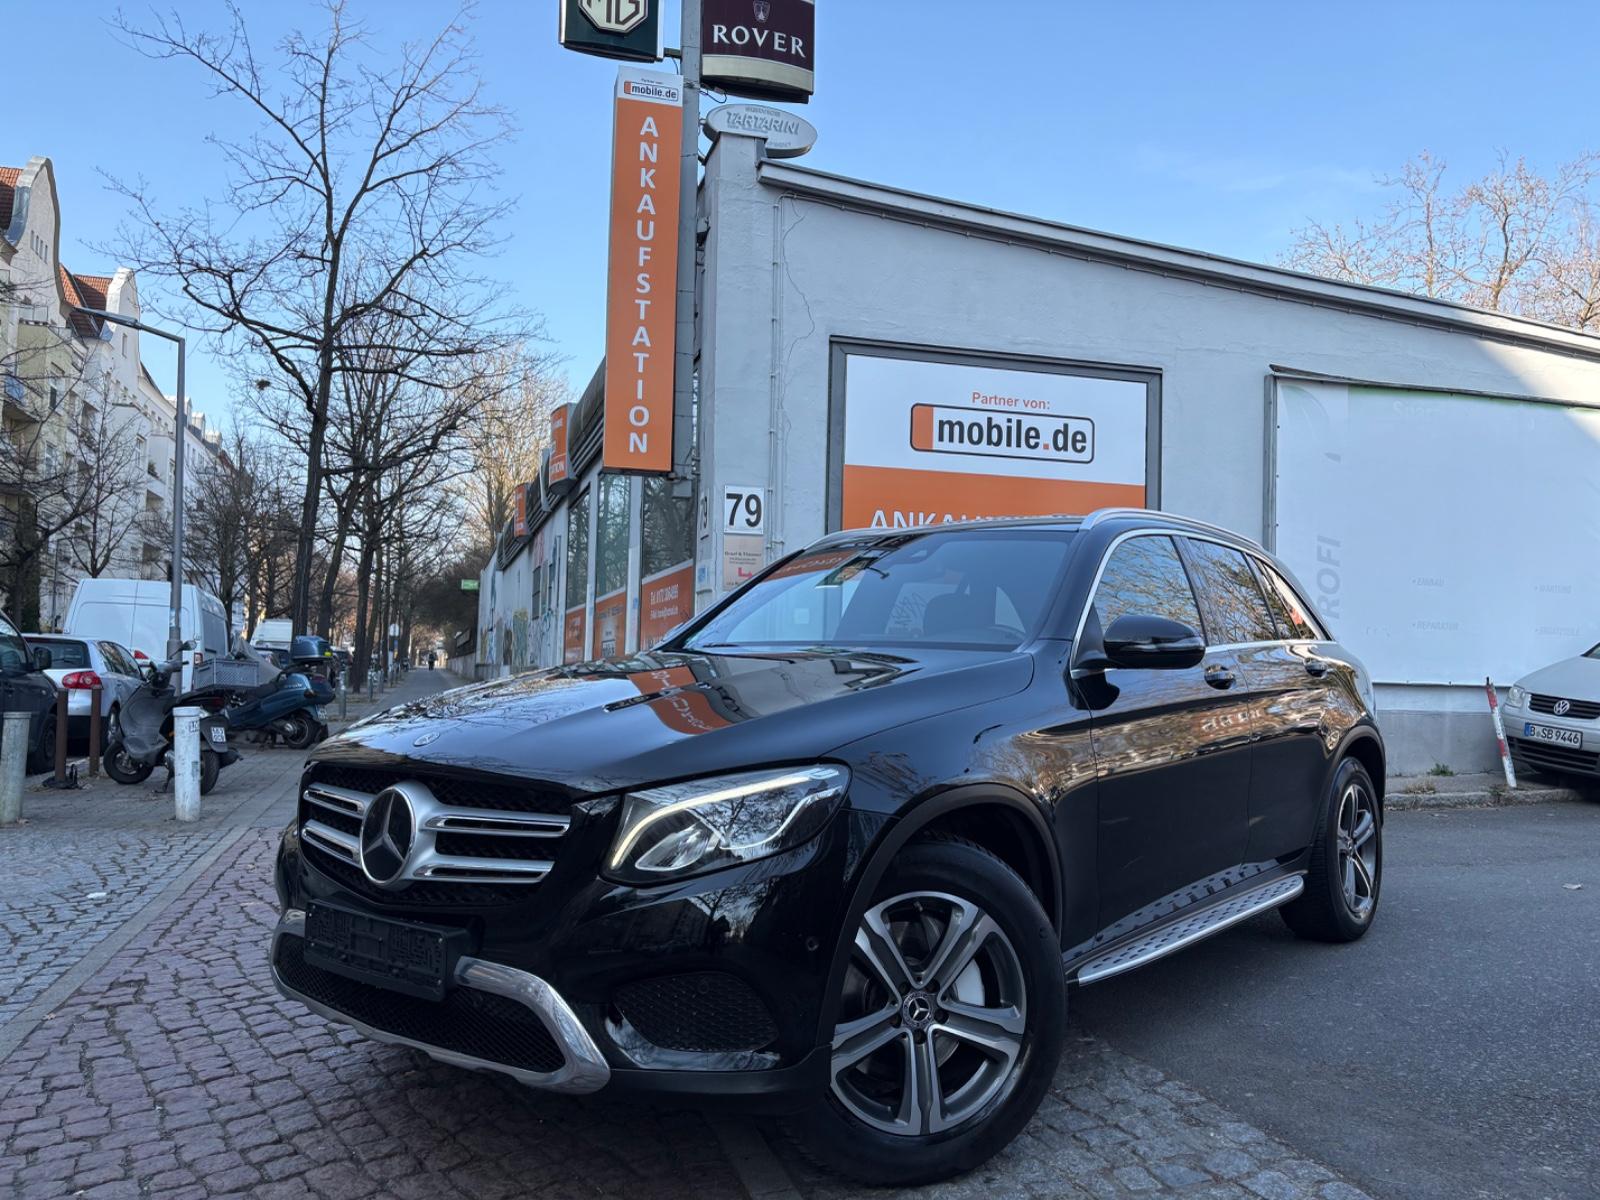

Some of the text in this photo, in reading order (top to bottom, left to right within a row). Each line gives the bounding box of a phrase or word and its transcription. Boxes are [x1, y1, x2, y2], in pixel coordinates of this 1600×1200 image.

[712, 24, 806, 58] ROVER
[631, 85, 677, 99] mobile.de
[726, 111, 800, 135] TARTARINI
[628, 116, 660, 454] ANKAUFSTATION
[971, 391, 1051, 410] Partner von:
[937, 416, 1087, 454] mobile.de
[725, 493, 762, 528] 79
[1316, 534, 1341, 620] ROFI
[1530, 725, 1579, 744] B SB 9446
